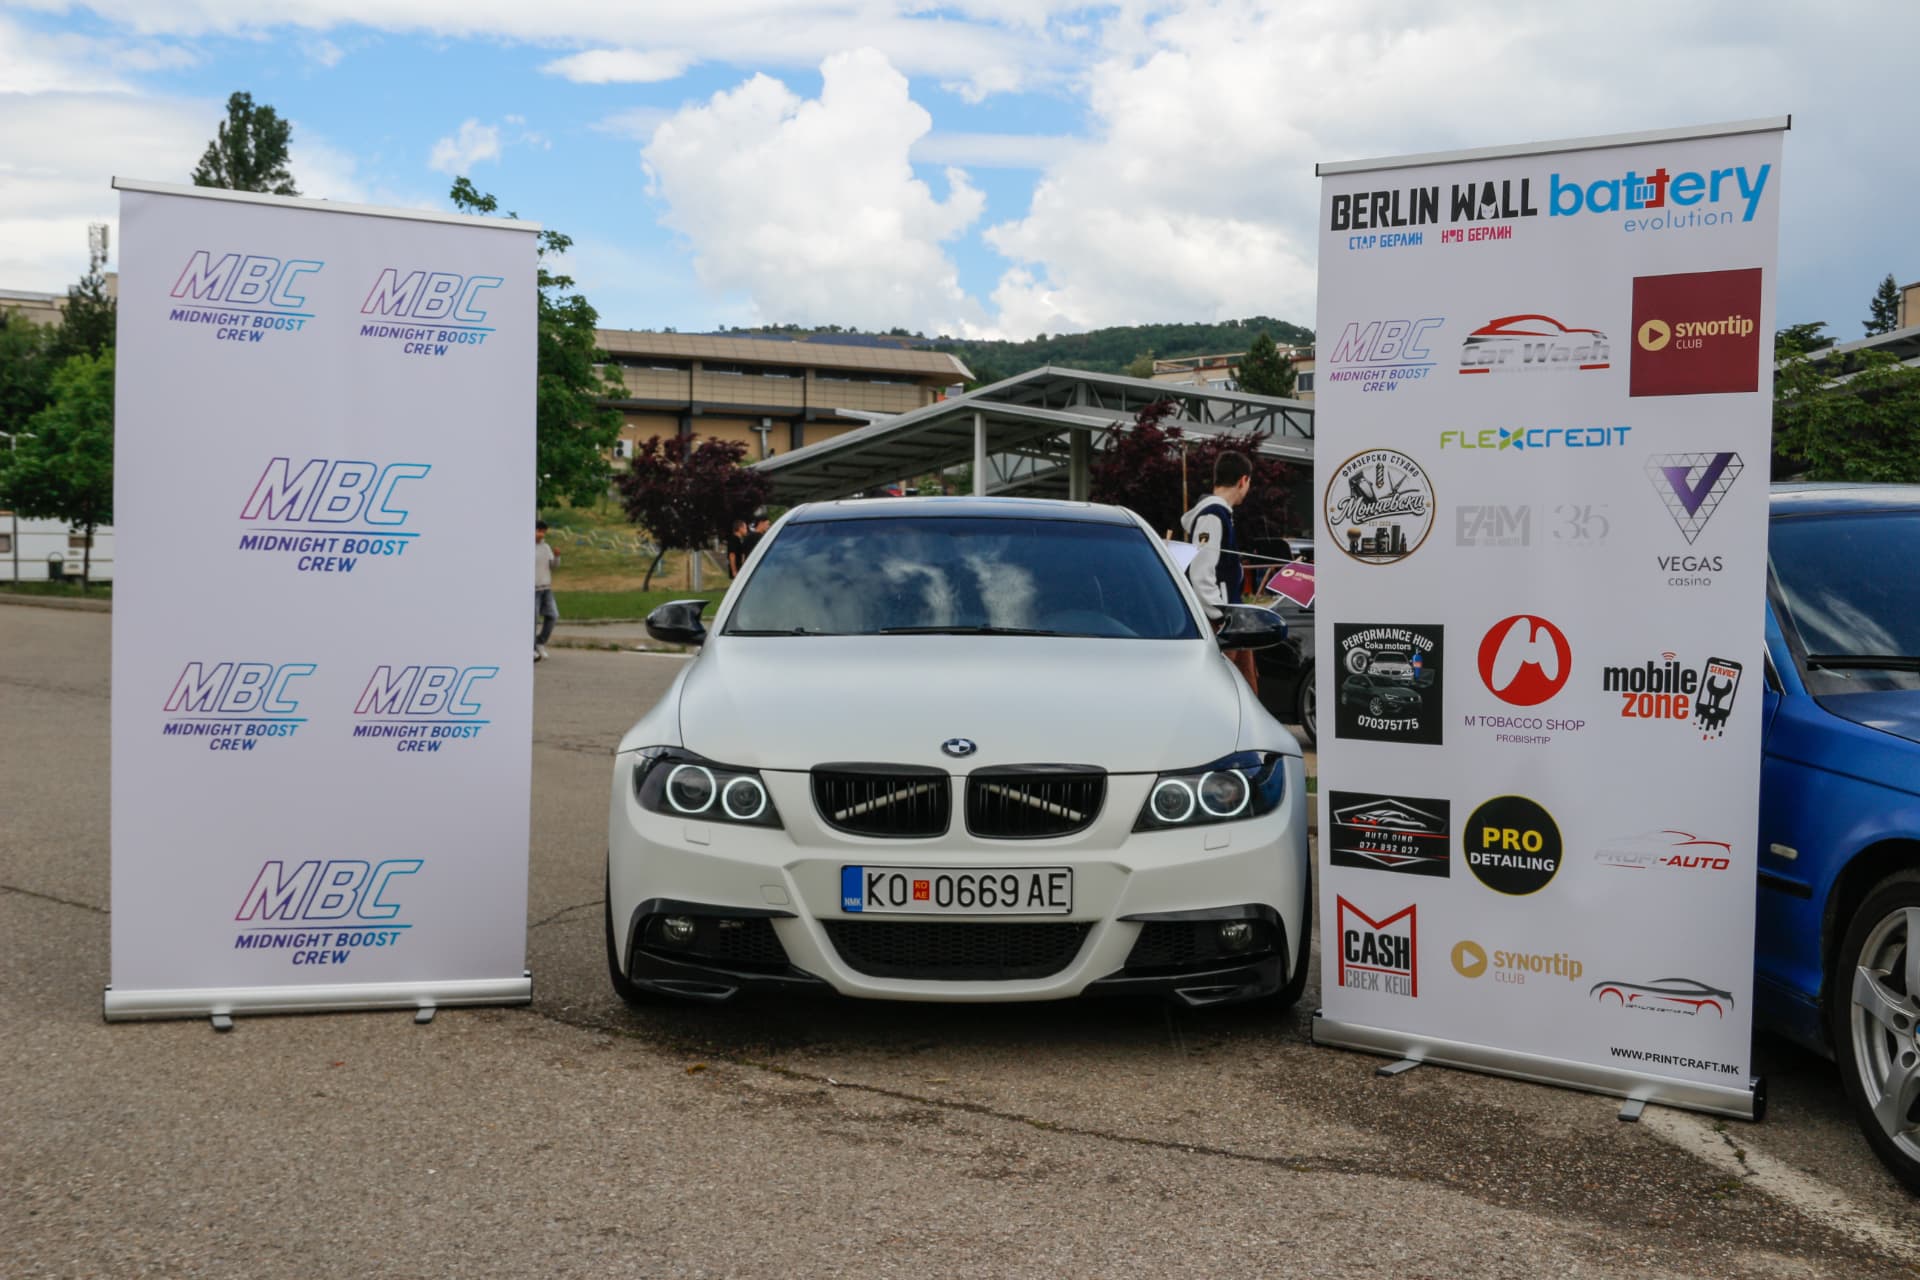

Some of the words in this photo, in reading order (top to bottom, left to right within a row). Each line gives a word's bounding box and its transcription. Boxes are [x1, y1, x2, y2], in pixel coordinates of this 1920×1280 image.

[1550, 164, 1772, 223] battery
[1331, 186, 1440, 231] BERLIN
[1450, 177, 1538, 223] WALL
[1624, 208, 1733, 233] evolution
[1380, 232, 1423, 248] БЕРЛИН
[1468, 225, 1512, 242] БЕРЛИН
[170, 250, 325, 308] MBC
[360, 268, 504, 322] MBC
[169, 308, 249, 328] MIDNIGHT
[252, 315, 306, 331] BOOST
[216, 327, 265, 343] CREW
[359, 324, 435, 342] MIDNIGHT
[436, 330, 487, 345] BOOST
[1330, 317, 1445, 363] MBC
[403, 342, 449, 357] CREW
[1676, 339, 1703, 350] CLUB
[1329, 370, 1388, 382] MIDNIGHT
[1389, 368, 1430, 379] BOOST
[1362, 381, 1398, 392] CREW
[239, 456, 432, 525] MBC
[239, 534, 339, 553] MIDNIGHT
[342, 539, 409, 555] BOOST
[297, 556, 357, 572] CREW
[1657, 556, 1723, 572] VEGAS
[1668, 576, 1711, 587] casino
[1342, 628, 1412, 650] PERFORMANCE
[1413, 634, 1434, 652] HUB
[1365, 642, 1383, 650] Coka
[1384, 642, 1411, 650] motors
[1603, 661, 1697, 694] mobile
[1709, 665, 1737, 679] SERVICE
[163, 661, 317, 713] MBC
[353, 665, 500, 715] MBC
[1621, 693, 1690, 720] zone
[163, 722, 242, 737] MIDNIGHT
[244, 723, 299, 737] BOOST
[353, 725, 428, 738] MIDNIGHT
[430, 725, 481, 739] BOOST
[1358, 715, 1419, 730] 070375775
[1465, 716, 1475, 727] M
[1478, 716, 1542, 730] TOBACCO
[1546, 719, 1585, 731] SHOP
[209, 738, 257, 751] CREW
[396, 740, 442, 753] CREW
[1496, 734, 1551, 744] PROBISHTIP
[1482, 826, 1543, 853] PRO
[1470, 852, 1555, 872] DETAILING
[234, 859, 424, 921] MBC
[935, 874, 1019, 908] 0669
[1027, 873, 1067, 907] AE
[234, 932, 333, 949] MIDNIGHT
[335, 931, 401, 947] BOOST
[1344, 929, 1410, 970] CASH
[292, 949, 350, 965] CREW
[1345, 969, 1380, 991] СВЕЖ
[1385, 976, 1411, 997] КЕШ
[1495, 971, 1525, 985] CLUB
[1610, 1046, 1740, 1075] WWW.PRINTCRAFT.MK
